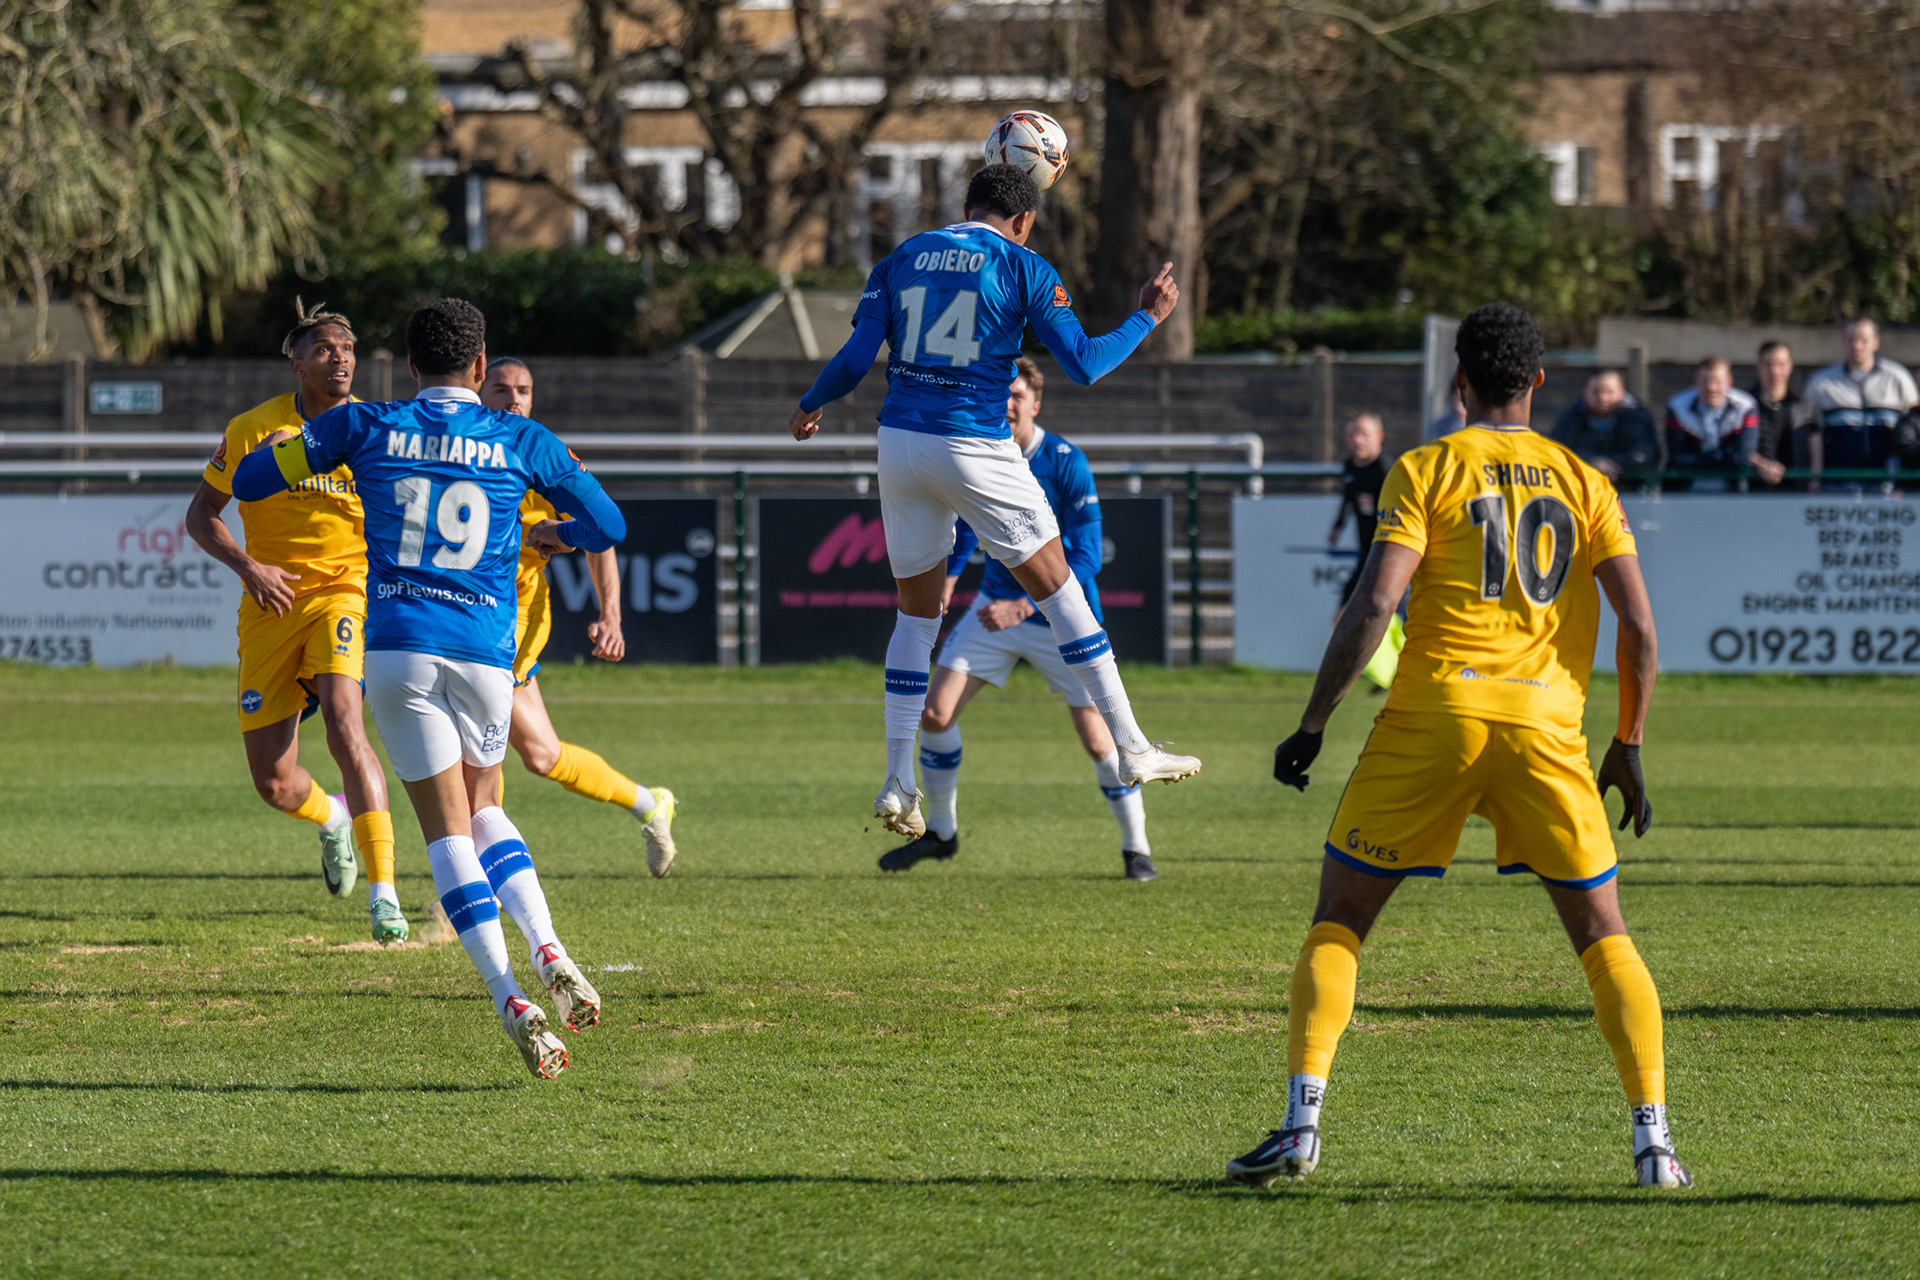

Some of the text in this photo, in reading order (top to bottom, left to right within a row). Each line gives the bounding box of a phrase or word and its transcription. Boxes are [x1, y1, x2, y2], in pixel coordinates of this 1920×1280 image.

[914, 249, 985, 273] OBIERO
[900, 285, 981, 367] 14
[387, 430, 508, 468] MARIAPPA
[1482, 463, 1552, 488] SHADE
[394, 476, 490, 570] 19
[1804, 505, 1916, 525] SERVICING
[1466, 491, 1575, 606] 10
[1818, 529, 1903, 548] REPAIRS
[1821, 551, 1899, 570] BRAKES
[43, 558, 222, 590] contract
[1796, 572, 1828, 592] OIL
[1743, 594, 1818, 615] ENGINE
[335, 616, 353, 643] 6
